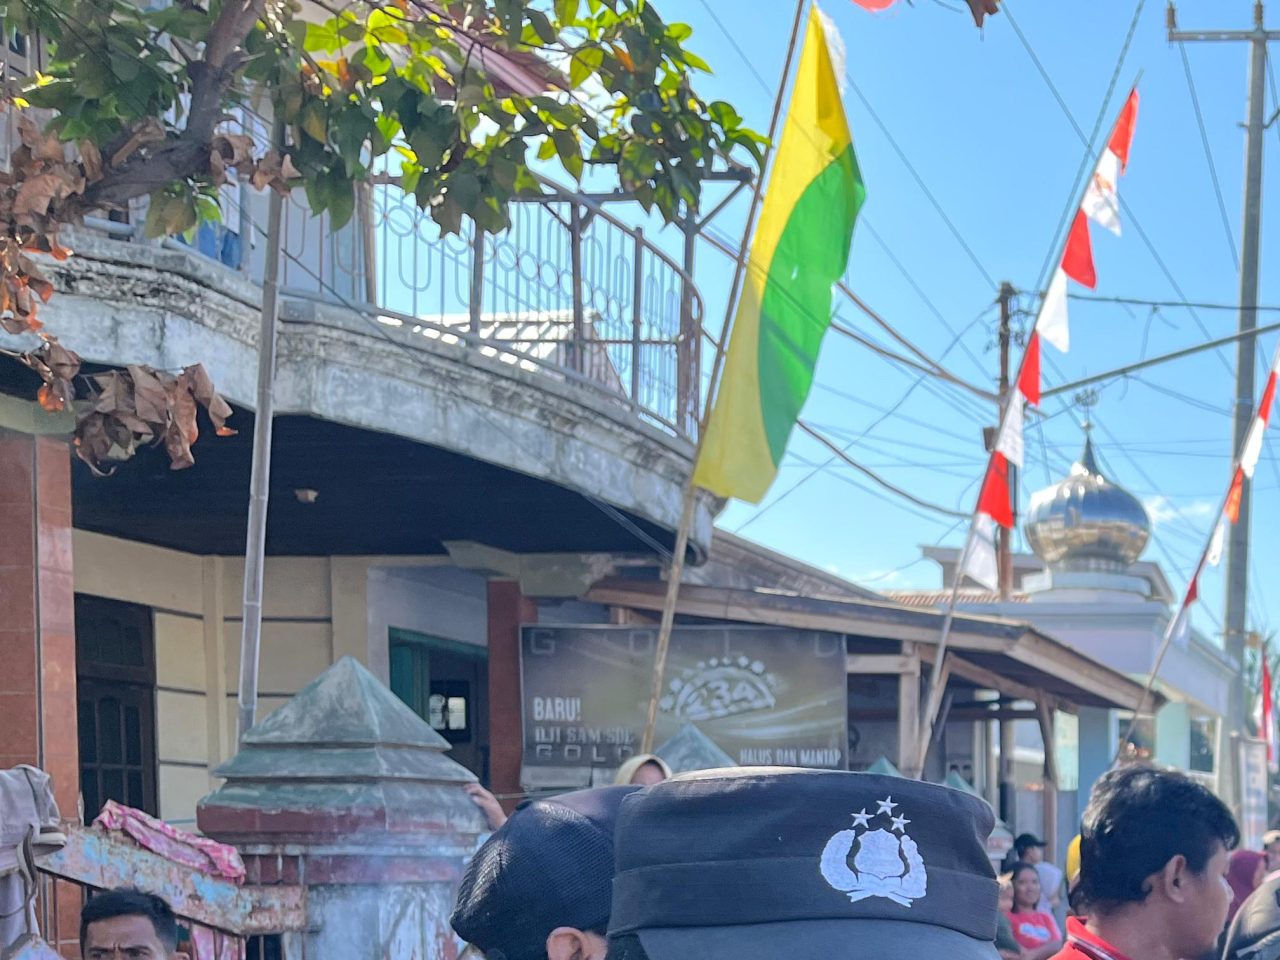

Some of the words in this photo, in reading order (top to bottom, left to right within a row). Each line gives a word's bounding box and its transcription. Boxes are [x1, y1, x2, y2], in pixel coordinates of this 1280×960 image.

[533, 696, 581, 721] BARU!
[566, 727, 601, 744] SAM
[740, 748, 772, 765] HALUS
[776, 749, 797, 766] DAN
[800, 749, 841, 767] MANTAP
